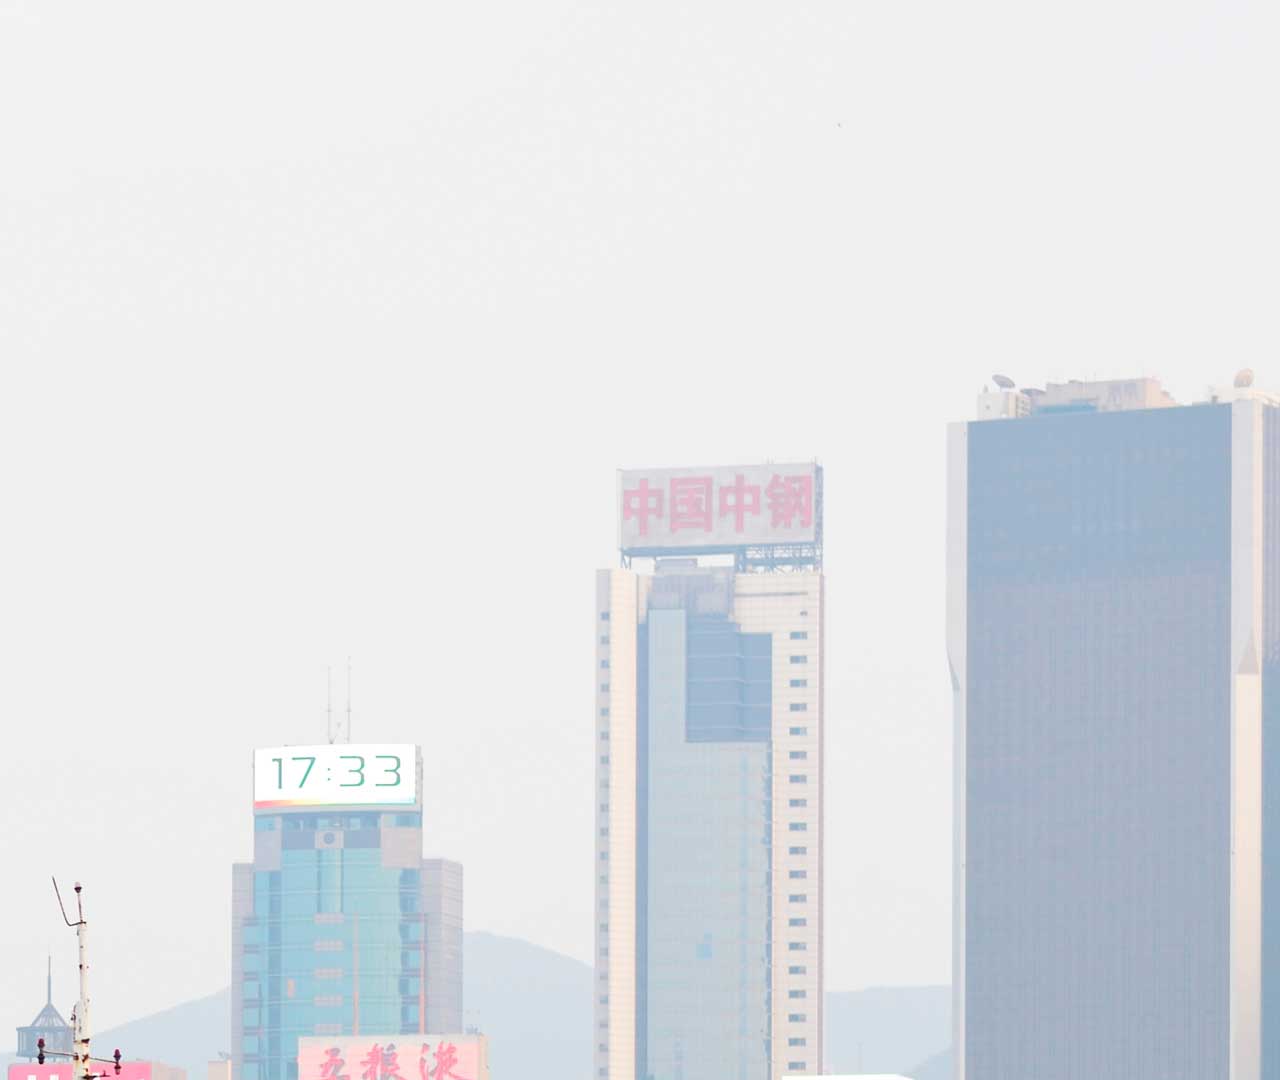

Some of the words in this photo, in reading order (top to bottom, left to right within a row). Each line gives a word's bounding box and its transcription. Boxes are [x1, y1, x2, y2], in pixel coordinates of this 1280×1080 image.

[623, 473, 813, 538] 中国中钢
[272, 755, 402, 790] 17:33
